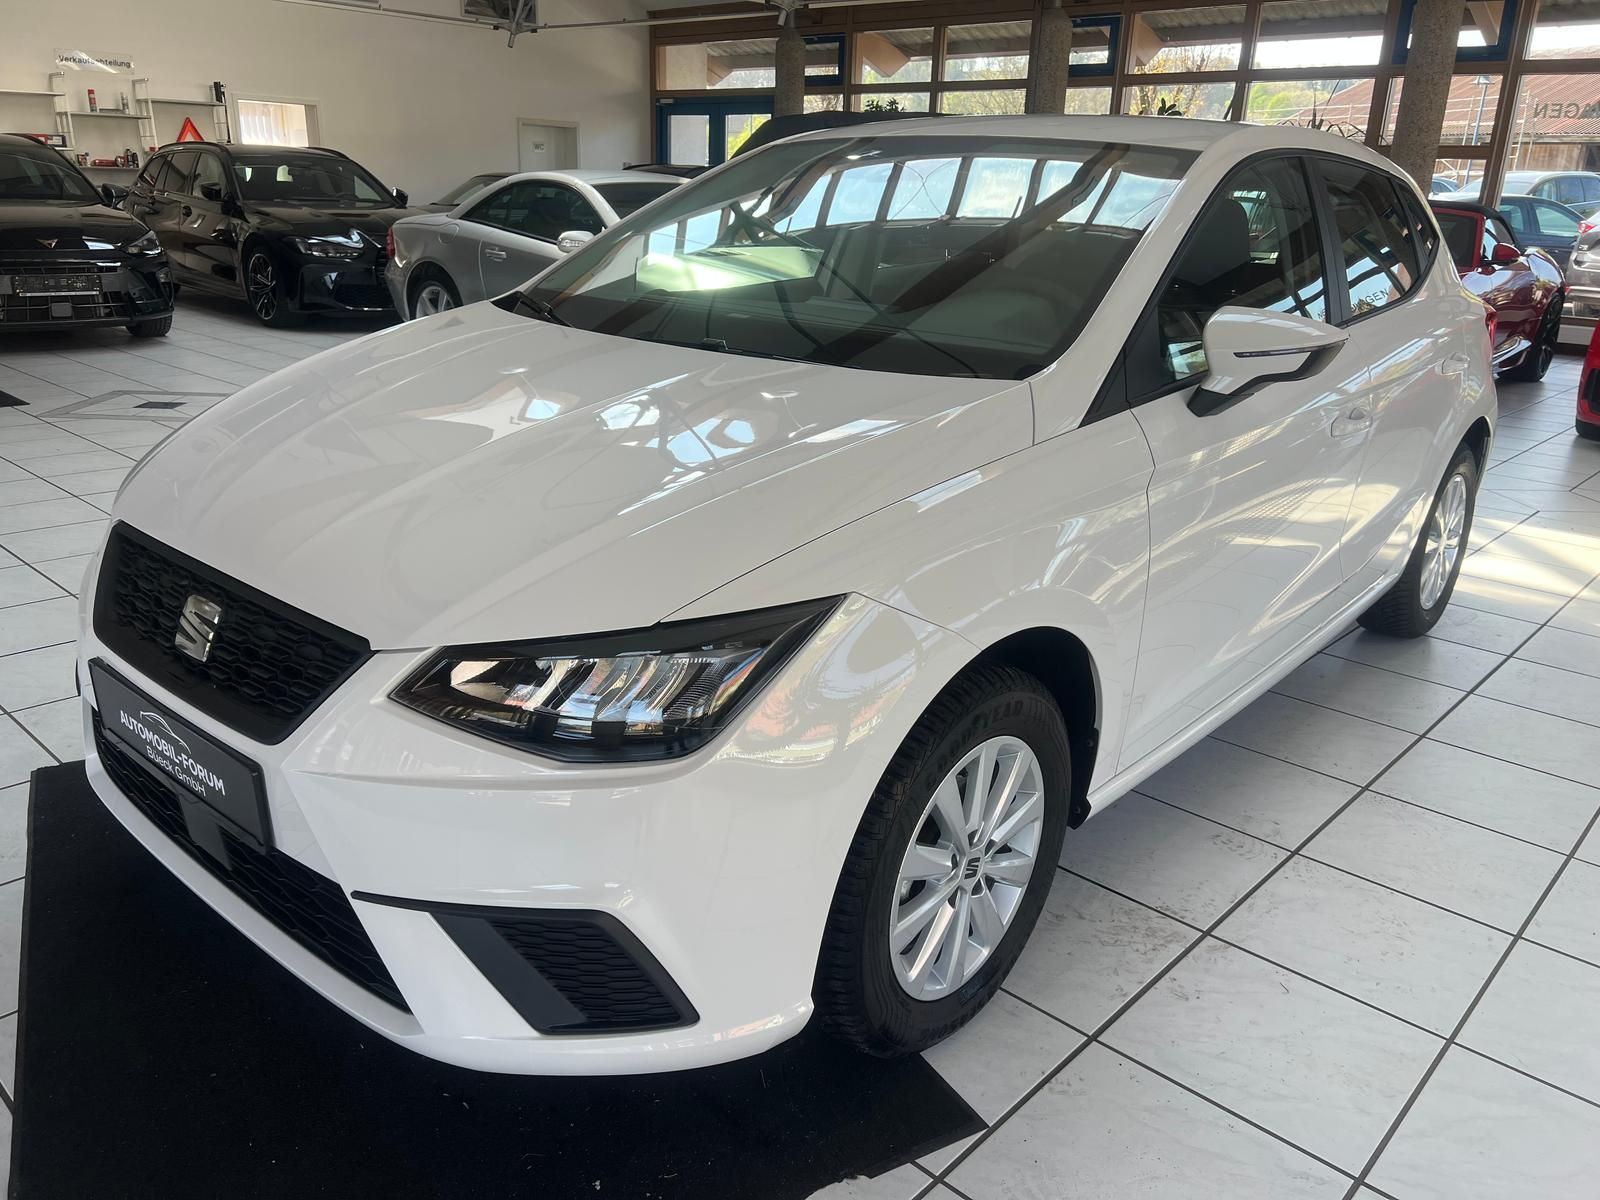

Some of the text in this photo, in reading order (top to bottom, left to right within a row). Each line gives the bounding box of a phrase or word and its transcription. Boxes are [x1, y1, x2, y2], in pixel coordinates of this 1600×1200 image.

[533, 143, 545, 151] WC
[120, 710, 225, 796] AUTOMOBIL-FORUM
[174, 765, 206, 797] GmbH
